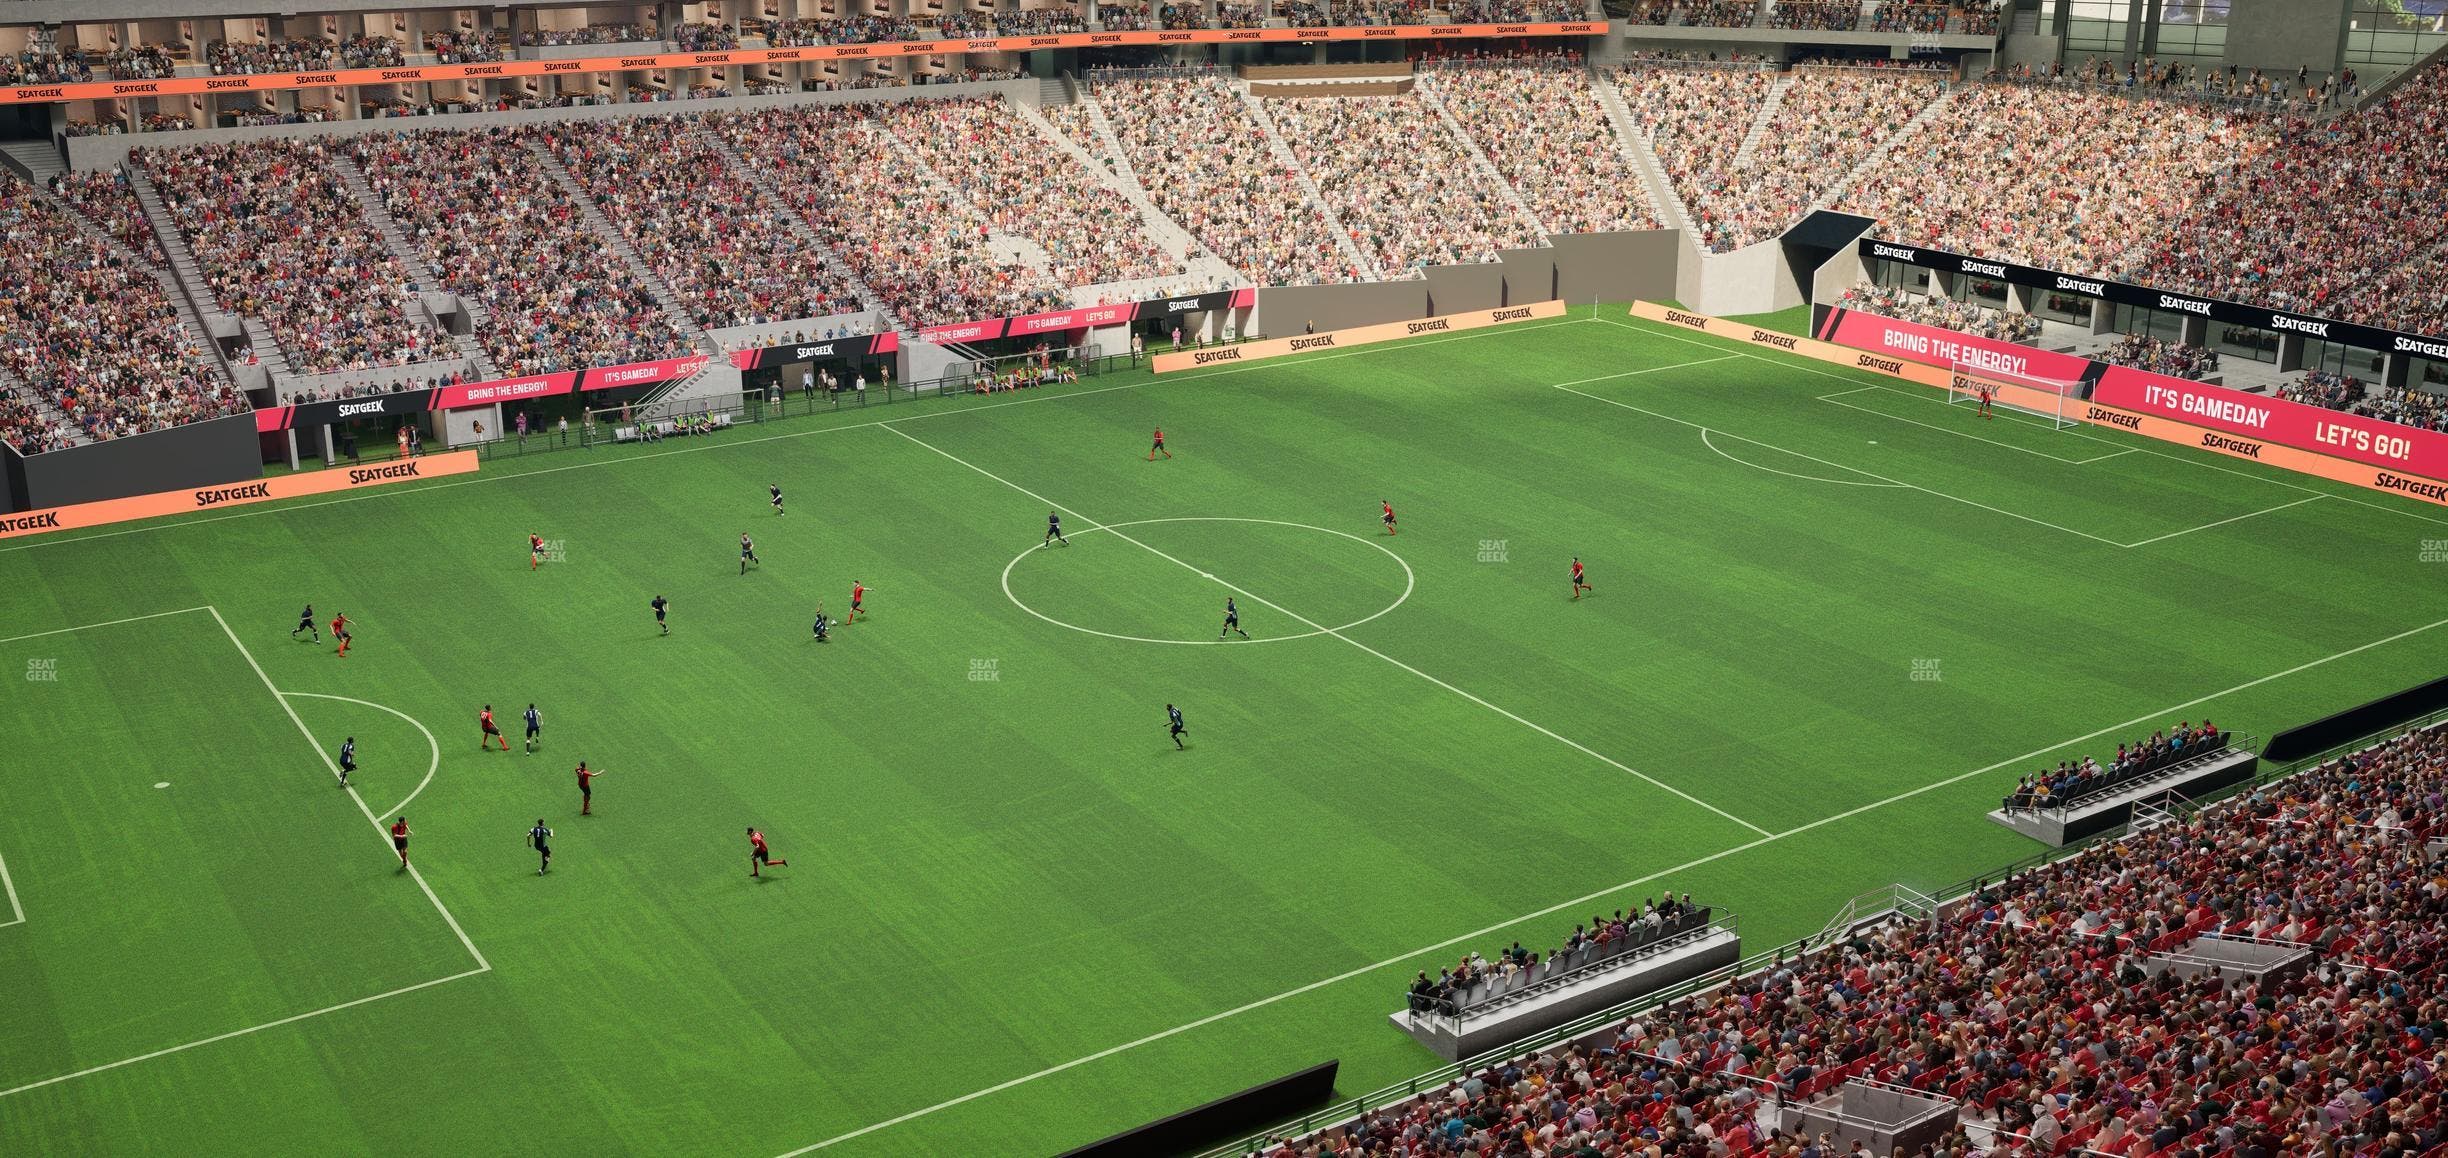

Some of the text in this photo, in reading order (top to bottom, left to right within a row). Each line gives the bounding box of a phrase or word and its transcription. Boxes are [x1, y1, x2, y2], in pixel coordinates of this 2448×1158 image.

[1365, 29, 1395, 37] SEATGEEK
[1497, 26, 1528, 34] SEATGEEK
[1561, 25, 1591, 33] SEATGEEK
[1031, 38, 1059, 46] SEATGEEK
[1092, 35, 1121, 43] SEATGEEK
[767, 51, 799, 60] SEATGEEK
[836, 47, 868, 56] SEATGEEK
[903, 44, 934, 52] SEATGEEK
[545, 62, 581, 72] SEATGEEK
[621, 58, 656, 68] SEATGEEK
[696, 55, 729, 64] SEATGEEK
[382, 70, 421, 80] SEATGEEK
[465, 66, 502, 76] SEATGEEK
[206, 79, 249, 89] SEATGEEK
[296, 74, 336, 84] SEATGEEK
[17, 89, 63, 99] SEATGEEK
[114, 83, 158, 94] SEATGEEK
[1874, 244, 1914, 262] SEATGEEK
[1961, 259, 2006, 279] SEATGEEK
[2056, 276, 2104, 296] SEATGEEK
[1169, 298, 1199, 312] SEATGEEK
[2159, 294, 2211, 316] SEATGEEK
[1493, 307, 1532, 322] SEATGEEK
[1666, 311, 1707, 330] SEATGEEK
[953, 327, 982, 339] ENERGY!
[1408, 319, 1448, 334] SEATGEEK
[2271, 315, 2328, 338] SEATGEEK
[1291, 334, 1334, 351] SEATGEEK
[1752, 330, 1798, 350] SEATGEEK
[797, 344, 834, 359] SEATGEEK
[1195, 347, 1241, 365] SEATGEEK
[1884, 329, 2027, 375] BRING THE ENERGY!
[1858, 354, 1904, 375] SEATGEEK
[605, 367, 658, 382] IT'S GAMEDAY
[468, 381, 548, 400] BRING THE ENERGY!
[339, 398, 384, 417] SEATGEEK
[2145, 385, 2270, 428] IT'S GAMEDAY
[2087, 406, 2142, 431] SEATGEEK
[2202, 433, 2261, 459] SEATGEEK
[2316, 422, 2411, 461] LET'S GO!
[350, 461, 419, 485] SEATGEEK
[196, 482, 270, 507] SEATGEEK
[2375, 473, 2448, 502] SEATGEEK
